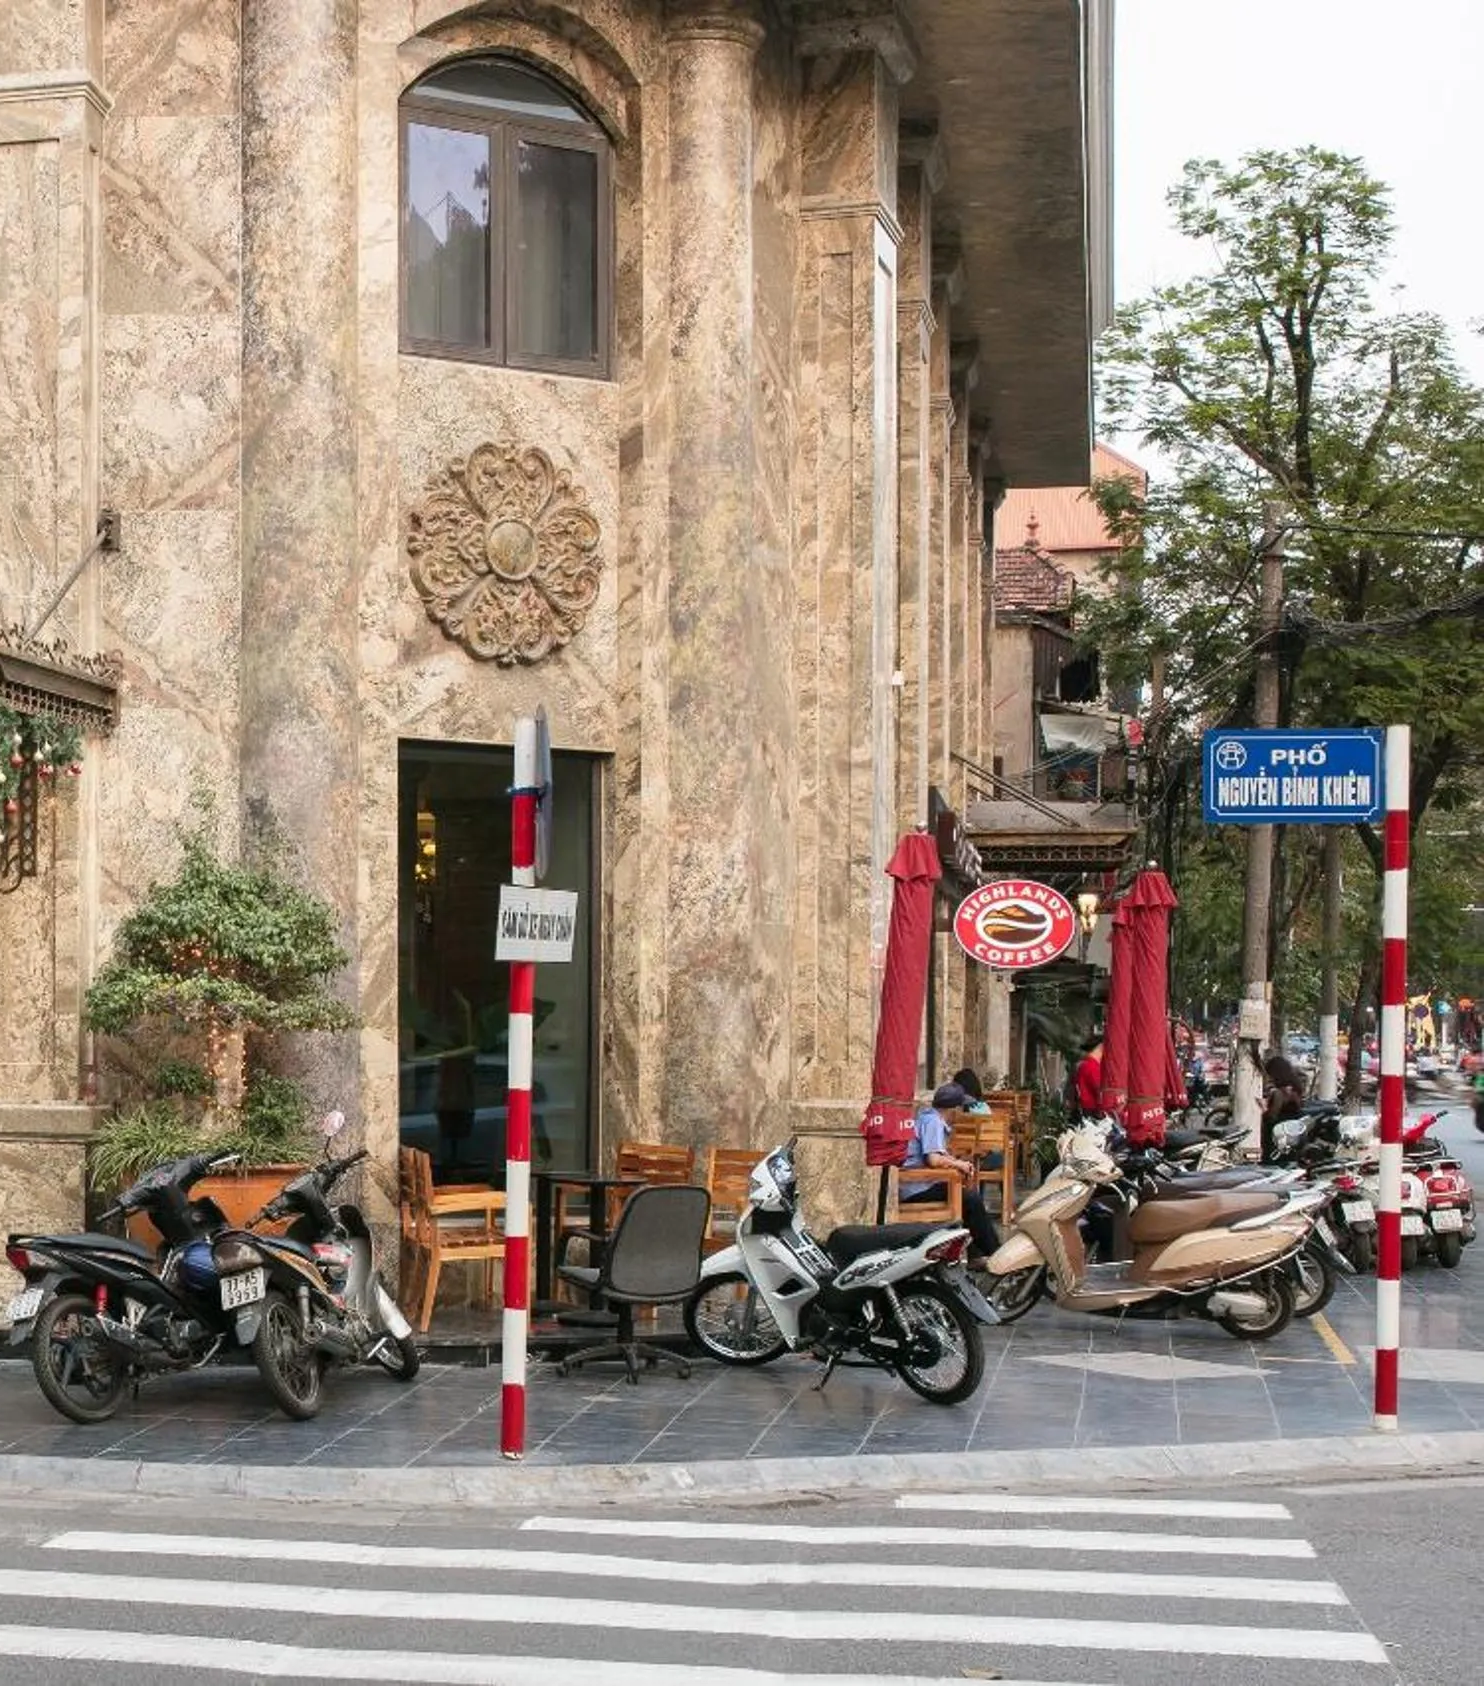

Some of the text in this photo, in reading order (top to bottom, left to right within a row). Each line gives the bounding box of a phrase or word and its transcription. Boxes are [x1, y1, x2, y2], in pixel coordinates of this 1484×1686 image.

[1270, 740, 1328, 766] PHỐ
[1218, 765, 1371, 808] NGUYỄN BỈNH KHIÊM
[961, 885, 1070, 920] HIGHLANDS
[974, 941, 1057, 963] COFFEE
